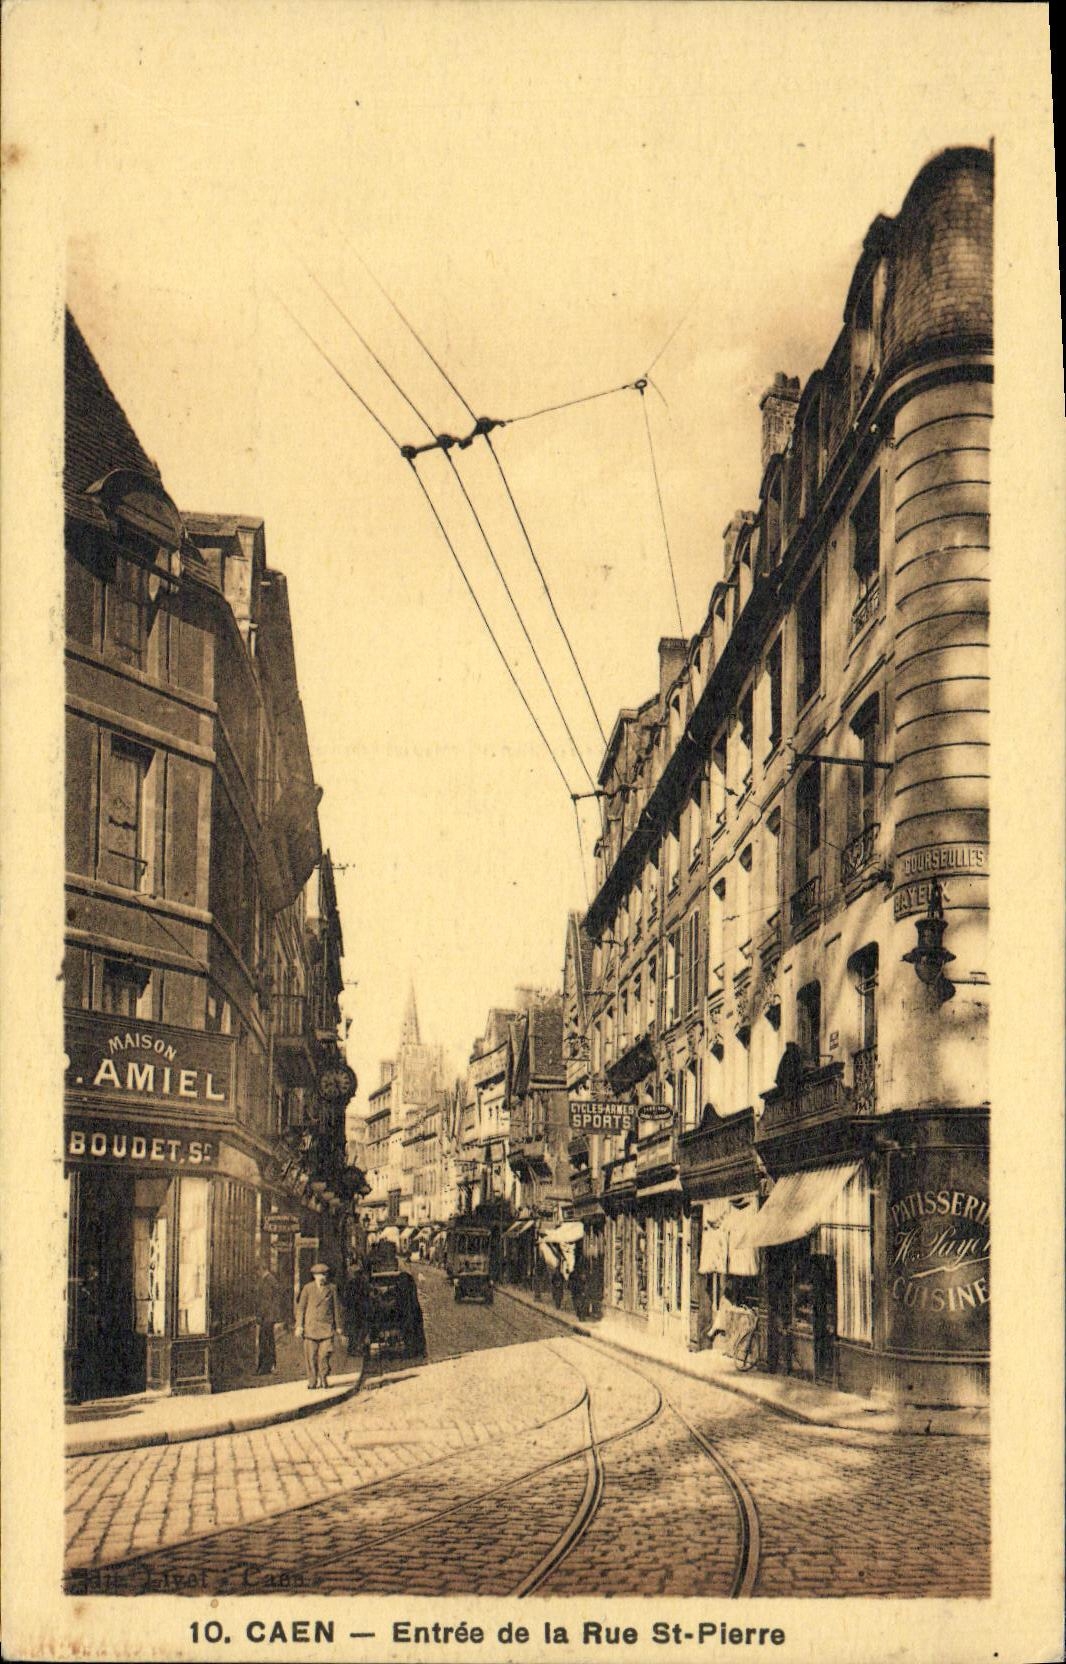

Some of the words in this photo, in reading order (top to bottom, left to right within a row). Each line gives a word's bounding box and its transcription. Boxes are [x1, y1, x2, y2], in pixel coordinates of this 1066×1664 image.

[108, 1033, 177, 1062] MAISON
[93, 1058, 225, 1101] AMIEL
[572, 1114, 631, 1129] SPORTS
[892, 1277, 990, 1312] CUISINE
